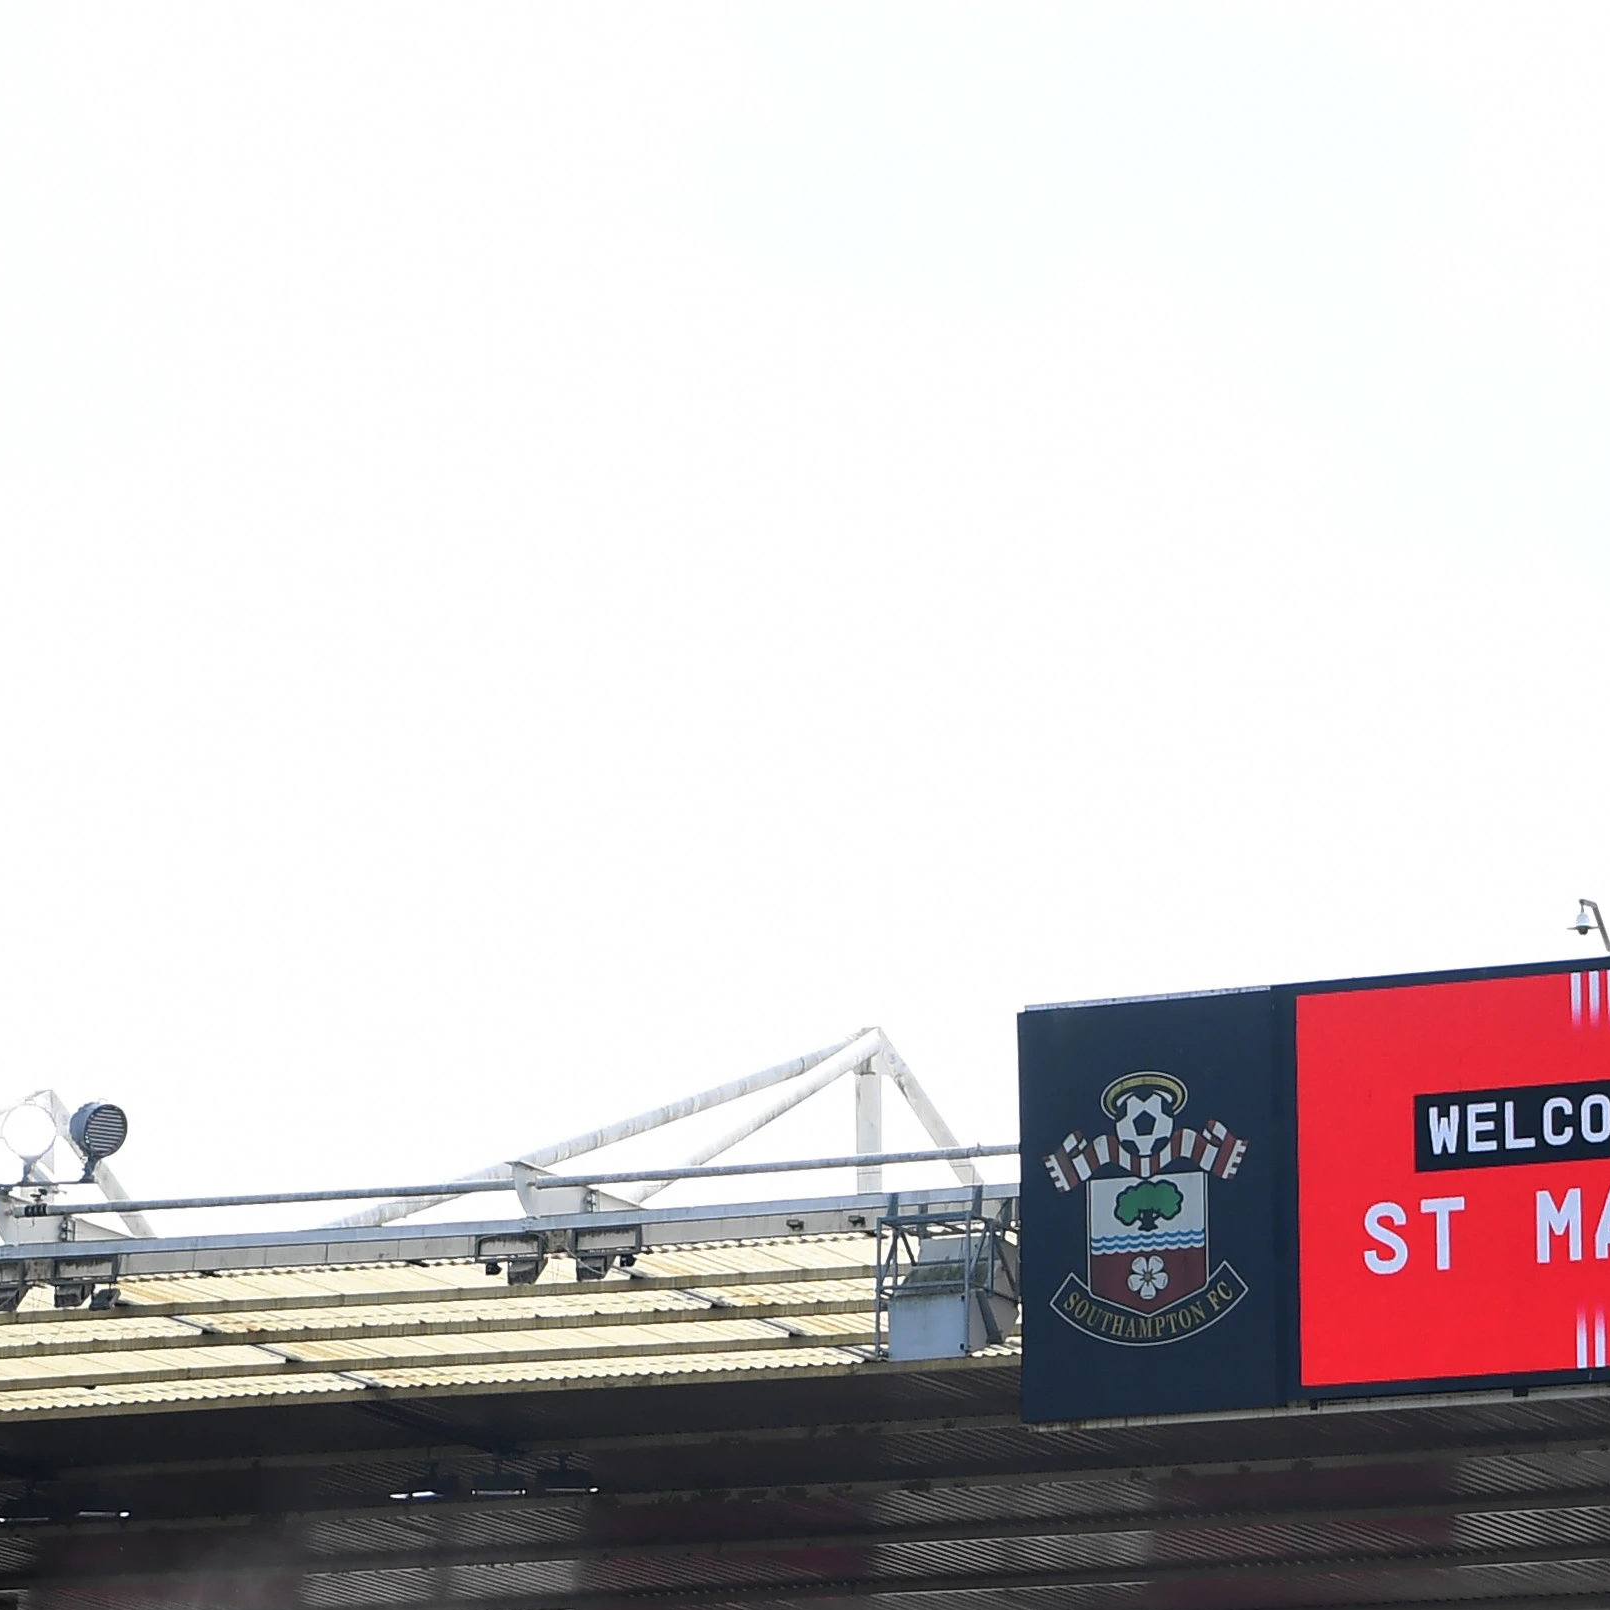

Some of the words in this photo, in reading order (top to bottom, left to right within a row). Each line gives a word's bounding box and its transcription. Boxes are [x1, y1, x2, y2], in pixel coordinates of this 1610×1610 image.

[1363, 1196, 1466, 1276] ST
[1063, 1291, 1207, 1339] SOUTHAMPTON
[1205, 1280, 1234, 1312] FC
